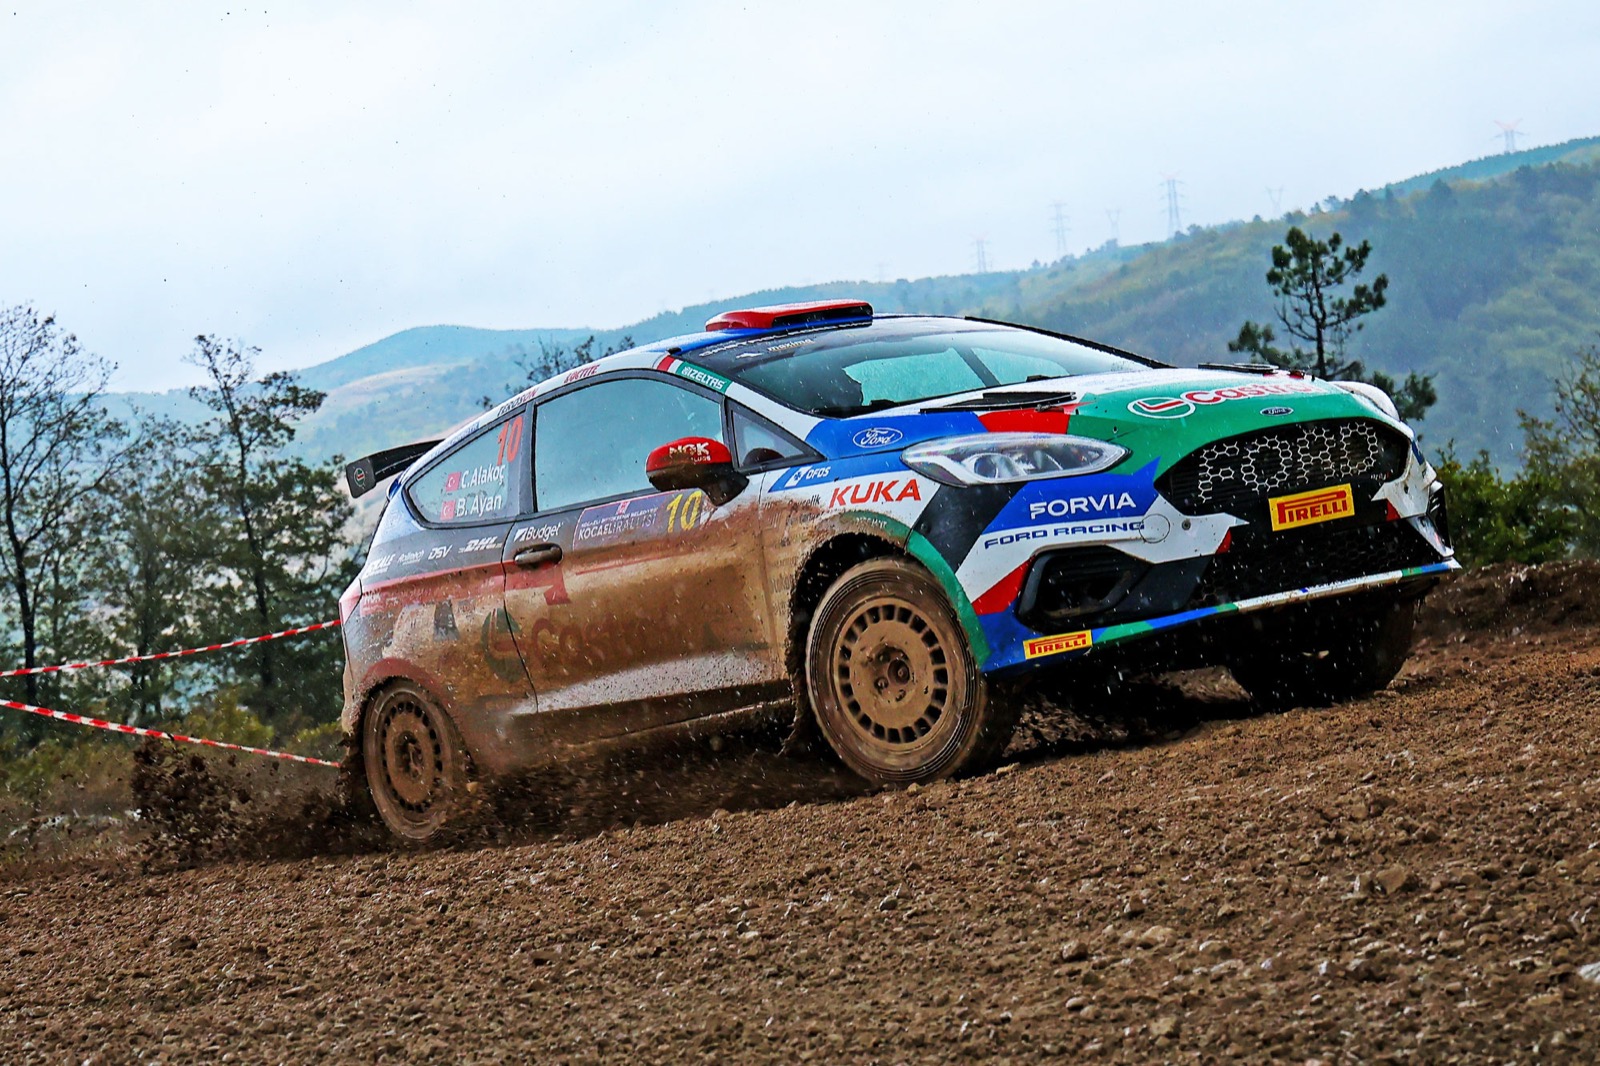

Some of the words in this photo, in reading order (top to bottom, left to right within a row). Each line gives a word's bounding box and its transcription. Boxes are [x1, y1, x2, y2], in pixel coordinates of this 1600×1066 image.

[497, 416, 523, 466] 10
[860, 430, 895, 446] Ford
[1199, 421, 1380, 503] FORD
[456, 497, 468, 517] B.
[470, 494, 502, 517] Ayan
[829, 479, 921, 508] KUKA
[1030, 491, 1136, 520] FORVIA
[1277, 490, 1347, 525] PIRELLI
[667, 490, 702, 533] 10
[526, 522, 562, 542] Budget
[984, 529, 1048, 550] FORD
[1053, 521, 1145, 537] RACING
[427, 545, 453, 561] DSV
[1028, 633, 1087, 656] PIRELLI
